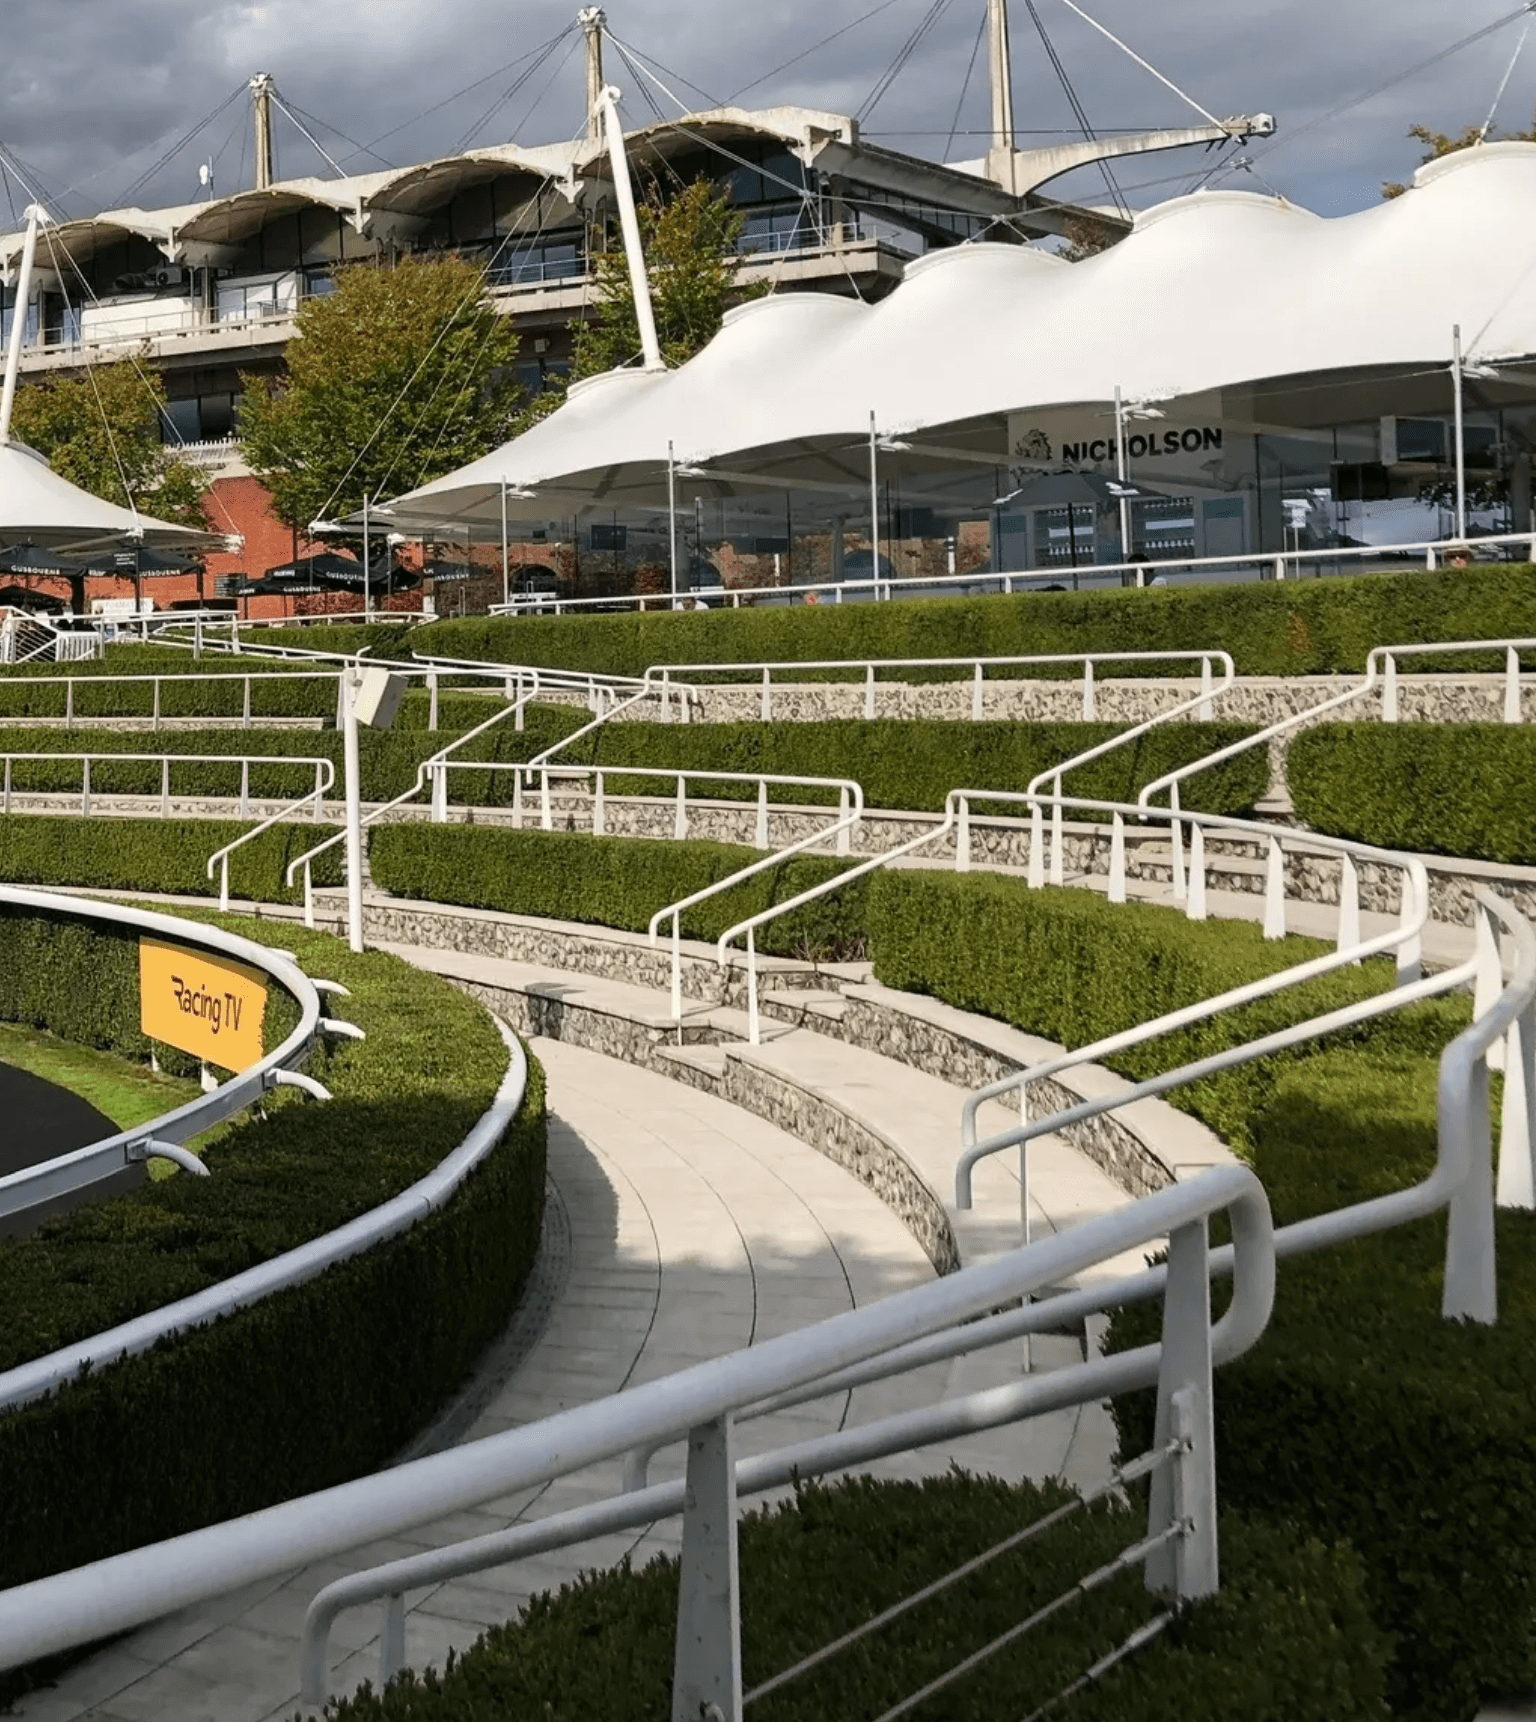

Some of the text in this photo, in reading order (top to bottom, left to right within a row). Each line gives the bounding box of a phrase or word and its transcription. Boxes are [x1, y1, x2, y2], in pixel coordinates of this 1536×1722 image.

[1062, 427, 1222, 462] NICHOLSON
[171, 975, 242, 1034] Racing TV
